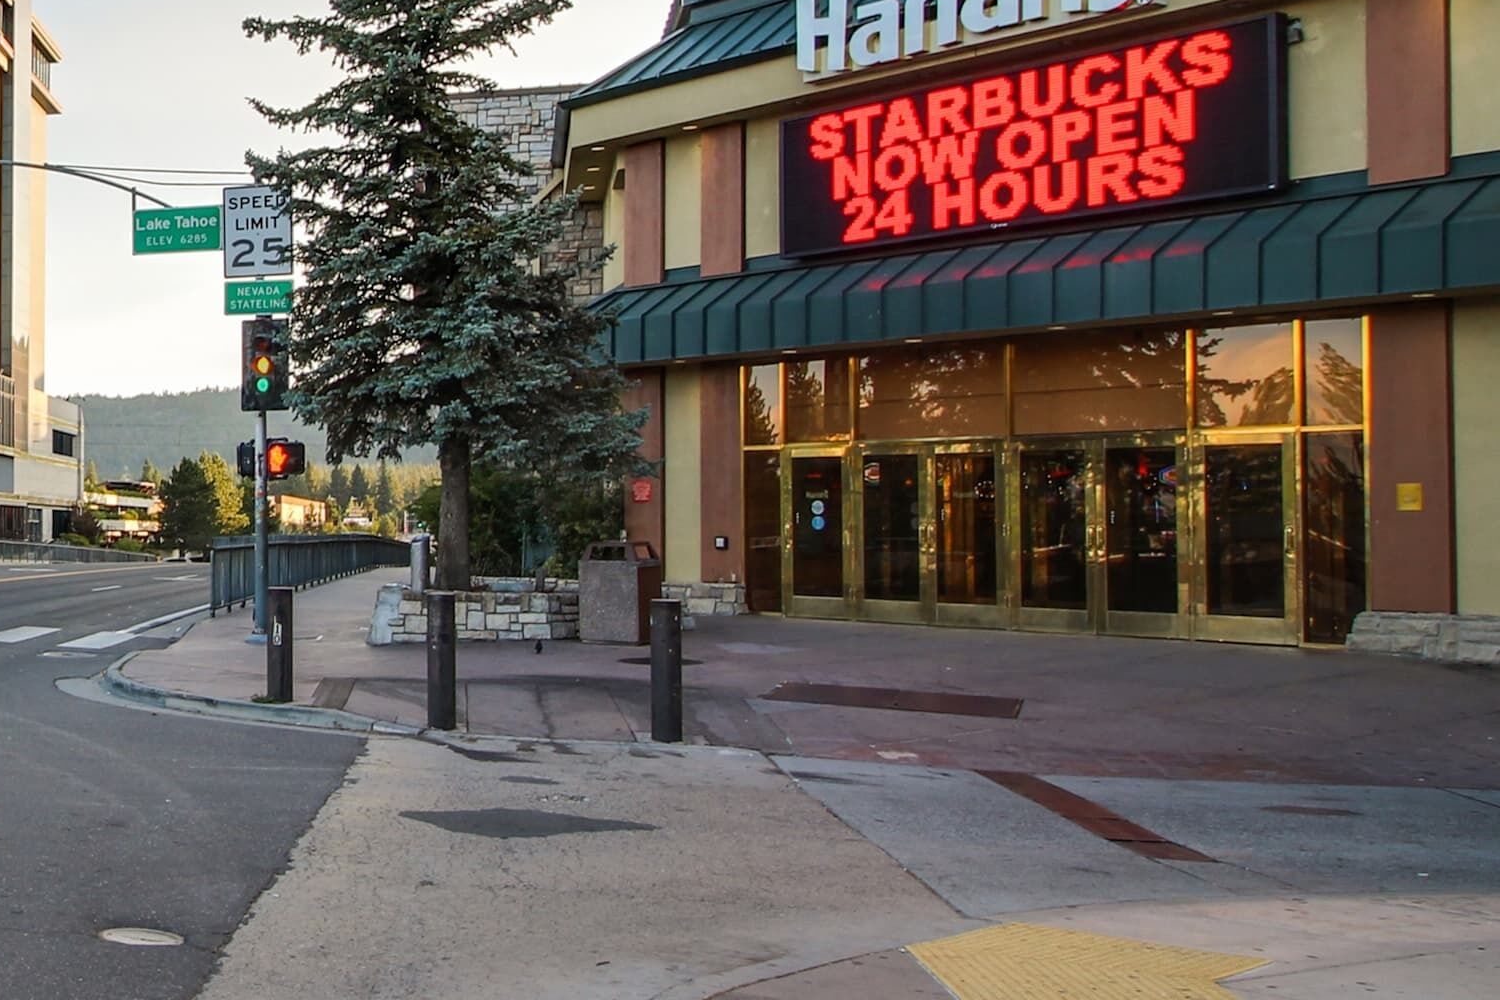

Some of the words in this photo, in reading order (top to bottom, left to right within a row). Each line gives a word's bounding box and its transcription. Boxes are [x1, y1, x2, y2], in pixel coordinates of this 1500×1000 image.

[810, 30, 1232, 161] STARBUCKS
[833, 130, 979, 201] NOW
[997, 89, 1195, 171] OPEN
[228, 194, 286, 210] SPEED
[843, 191, 914, 244] 24
[933, 144, 1186, 230] HOURS
[136, 217, 171, 231] Lake
[174, 214, 218, 229] Tahoe
[235, 215, 279, 231] LIMIT
[146, 236, 173, 246] ELEV
[180, 233, 208, 244] 6285
[231, 237, 286, 268] 25
[237, 286, 280, 297] NEVADA
[230, 298, 287, 310] STATELINE
